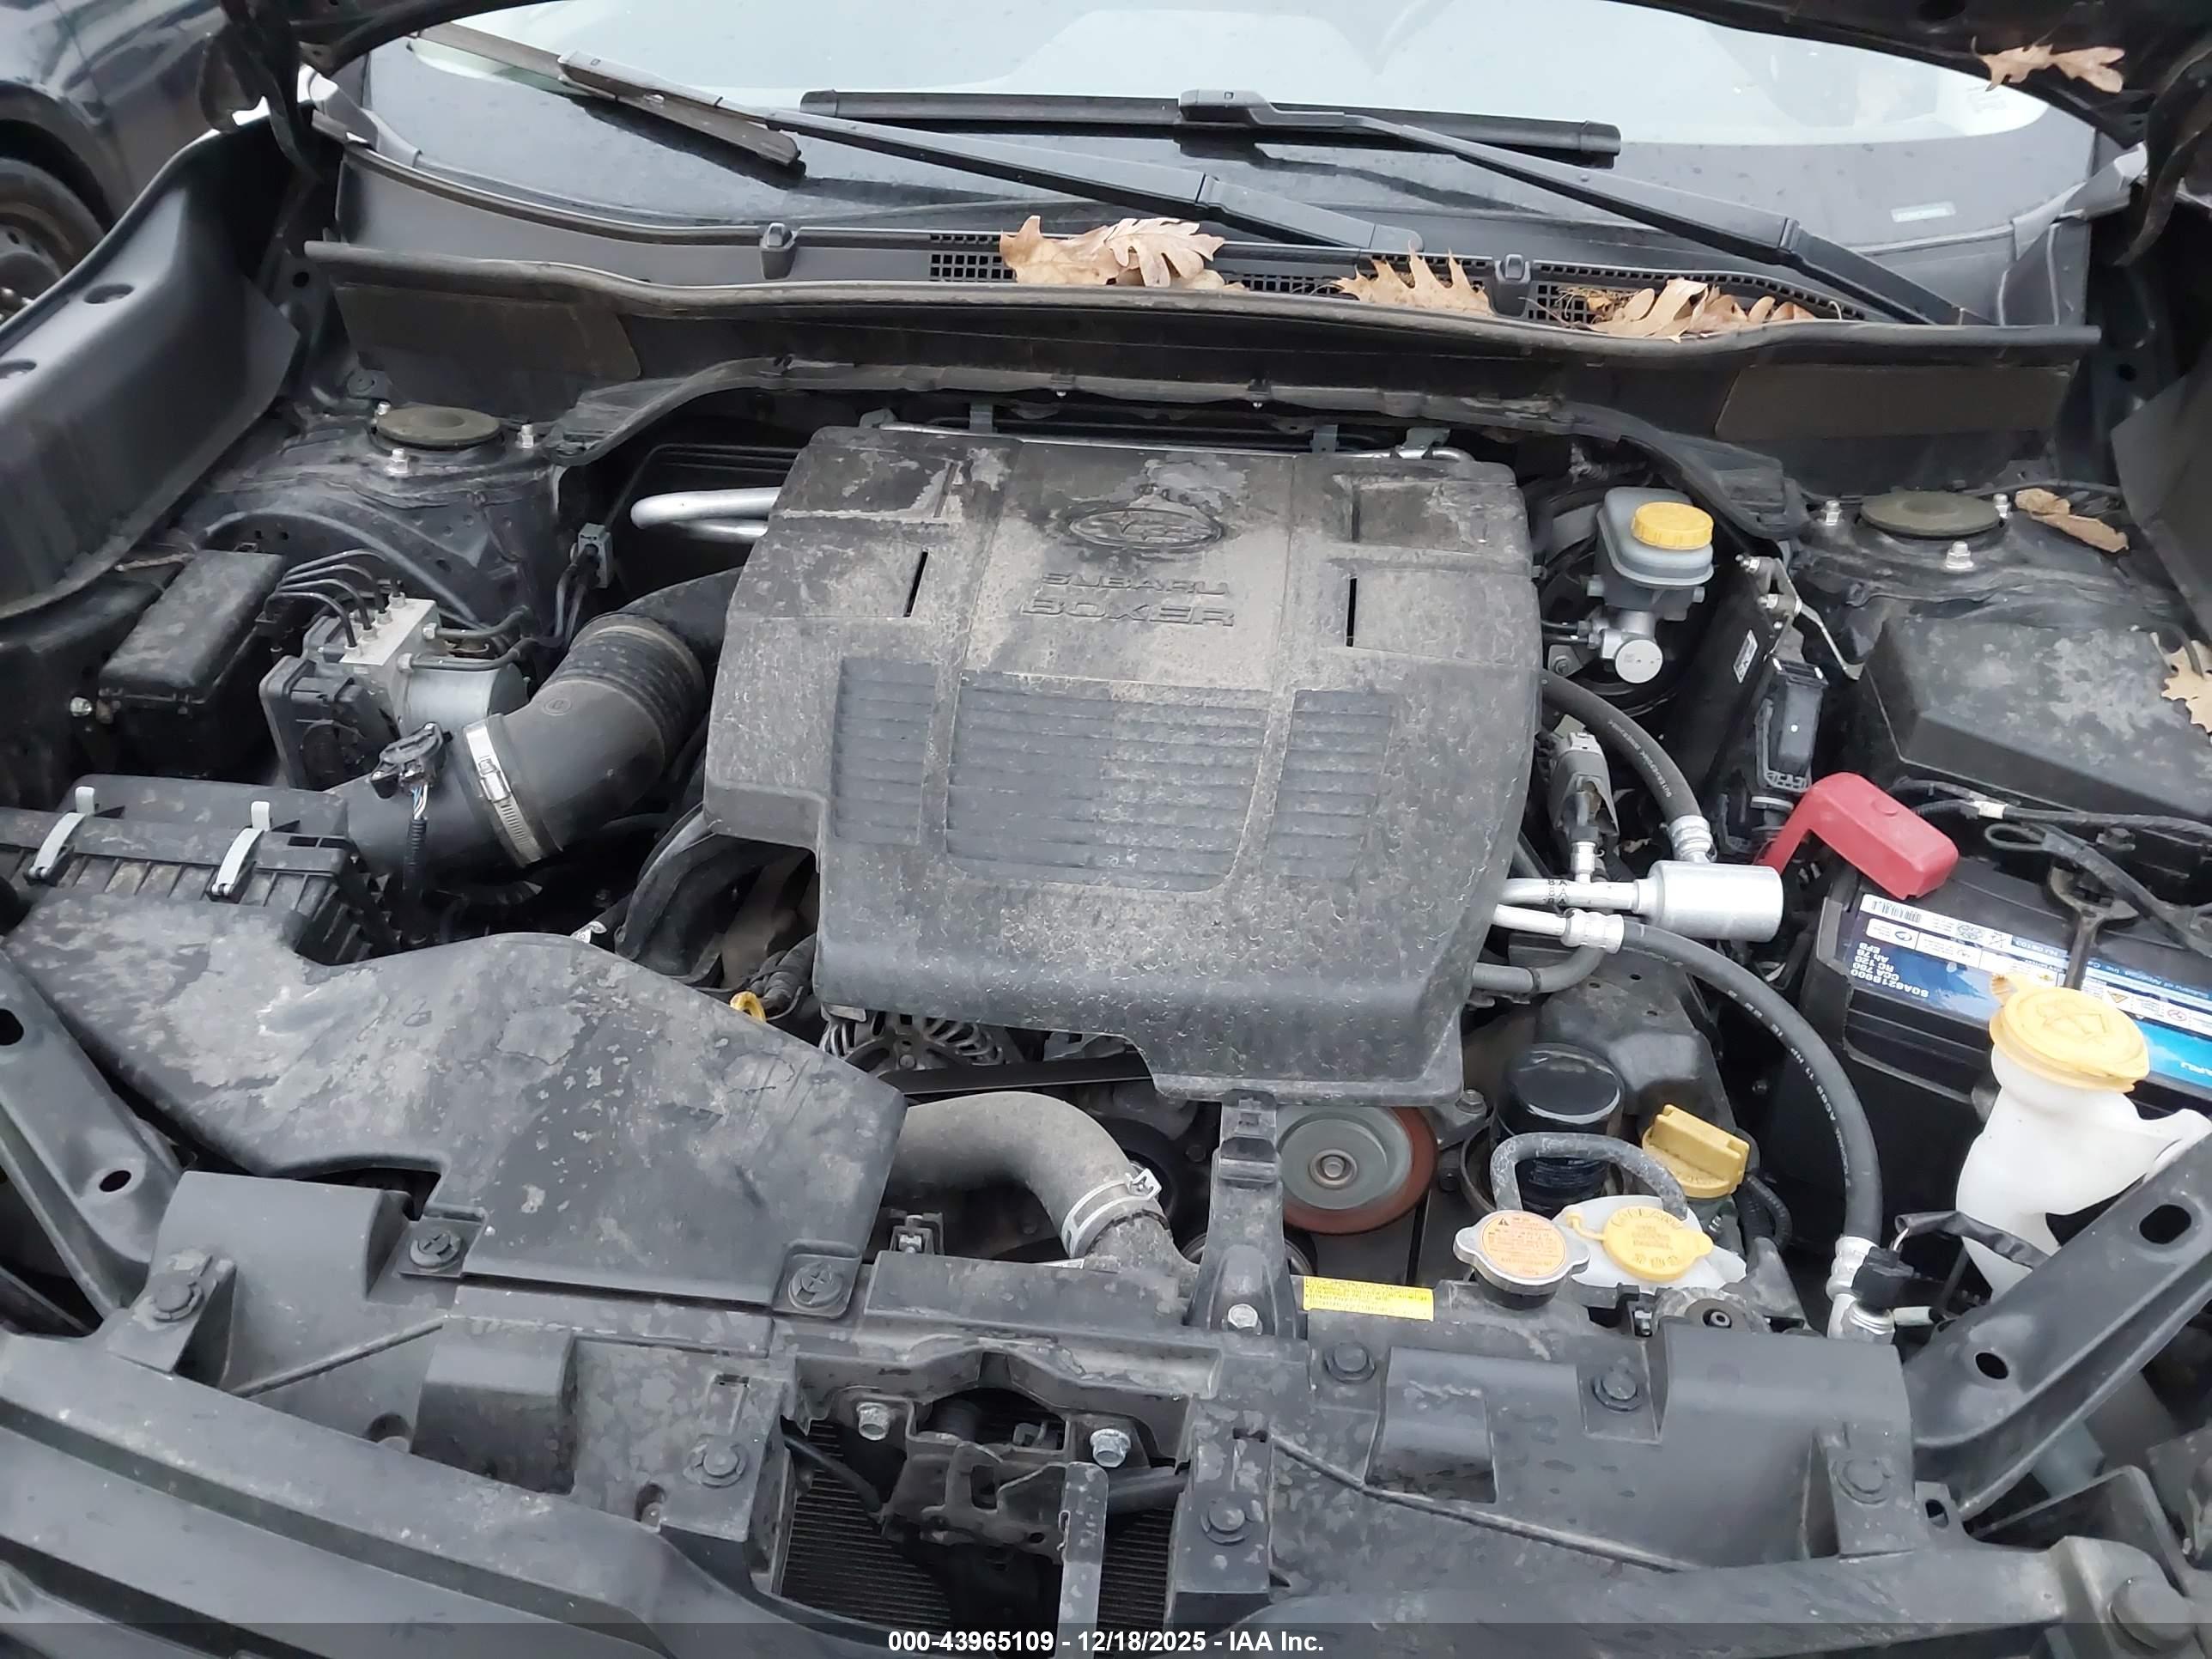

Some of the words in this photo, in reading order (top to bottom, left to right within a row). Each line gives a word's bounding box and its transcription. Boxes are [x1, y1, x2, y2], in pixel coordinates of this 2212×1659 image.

[1041, 573, 1229, 595] SUBARU
[1021, 599, 1235, 627] BOXER
[1855, 956, 1875, 966] 120
[1873, 953, 1889, 963] Ah
[1878, 962, 1894, 972] RC
[1876, 970, 1900, 981] CCA
